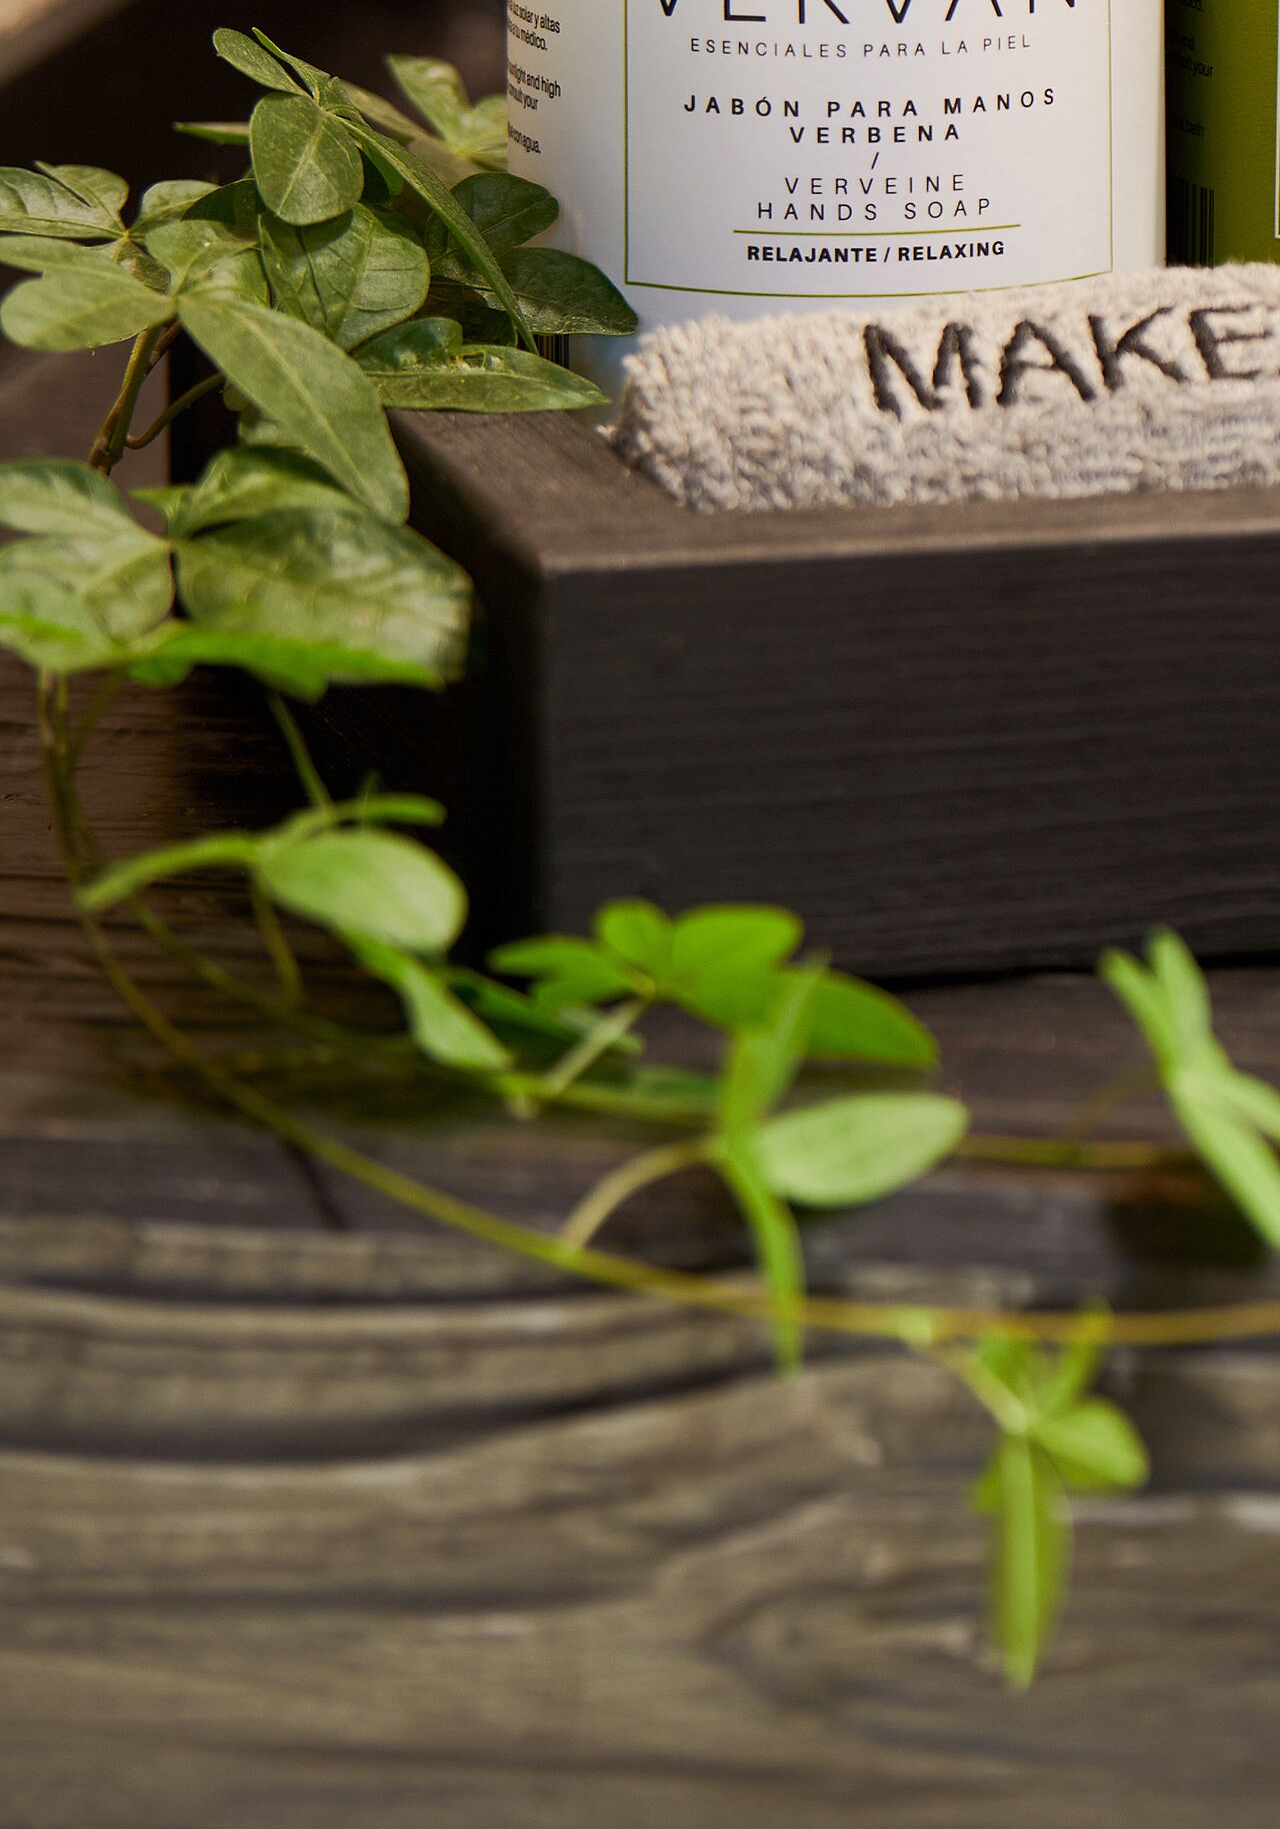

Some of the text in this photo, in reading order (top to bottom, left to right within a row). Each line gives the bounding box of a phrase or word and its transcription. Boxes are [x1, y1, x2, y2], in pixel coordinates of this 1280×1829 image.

[539, 14, 561, 33] altas
[690, 35, 1030, 58] ESENCIALES PARA LA PIEL
[526, 72, 540, 90] and
[541, 76, 562, 98] high
[523, 94, 539, 110] your
[683, 88, 1054, 118] JABÓN PARA MANOS
[789, 123, 959, 144] VERBENA
[784, 174, 963, 195] VERVEINE
[757, 198, 990, 221] HANDS SOAP
[747, 245, 877, 263] RELAJANTE
[898, 240, 1004, 262] RELAXING
